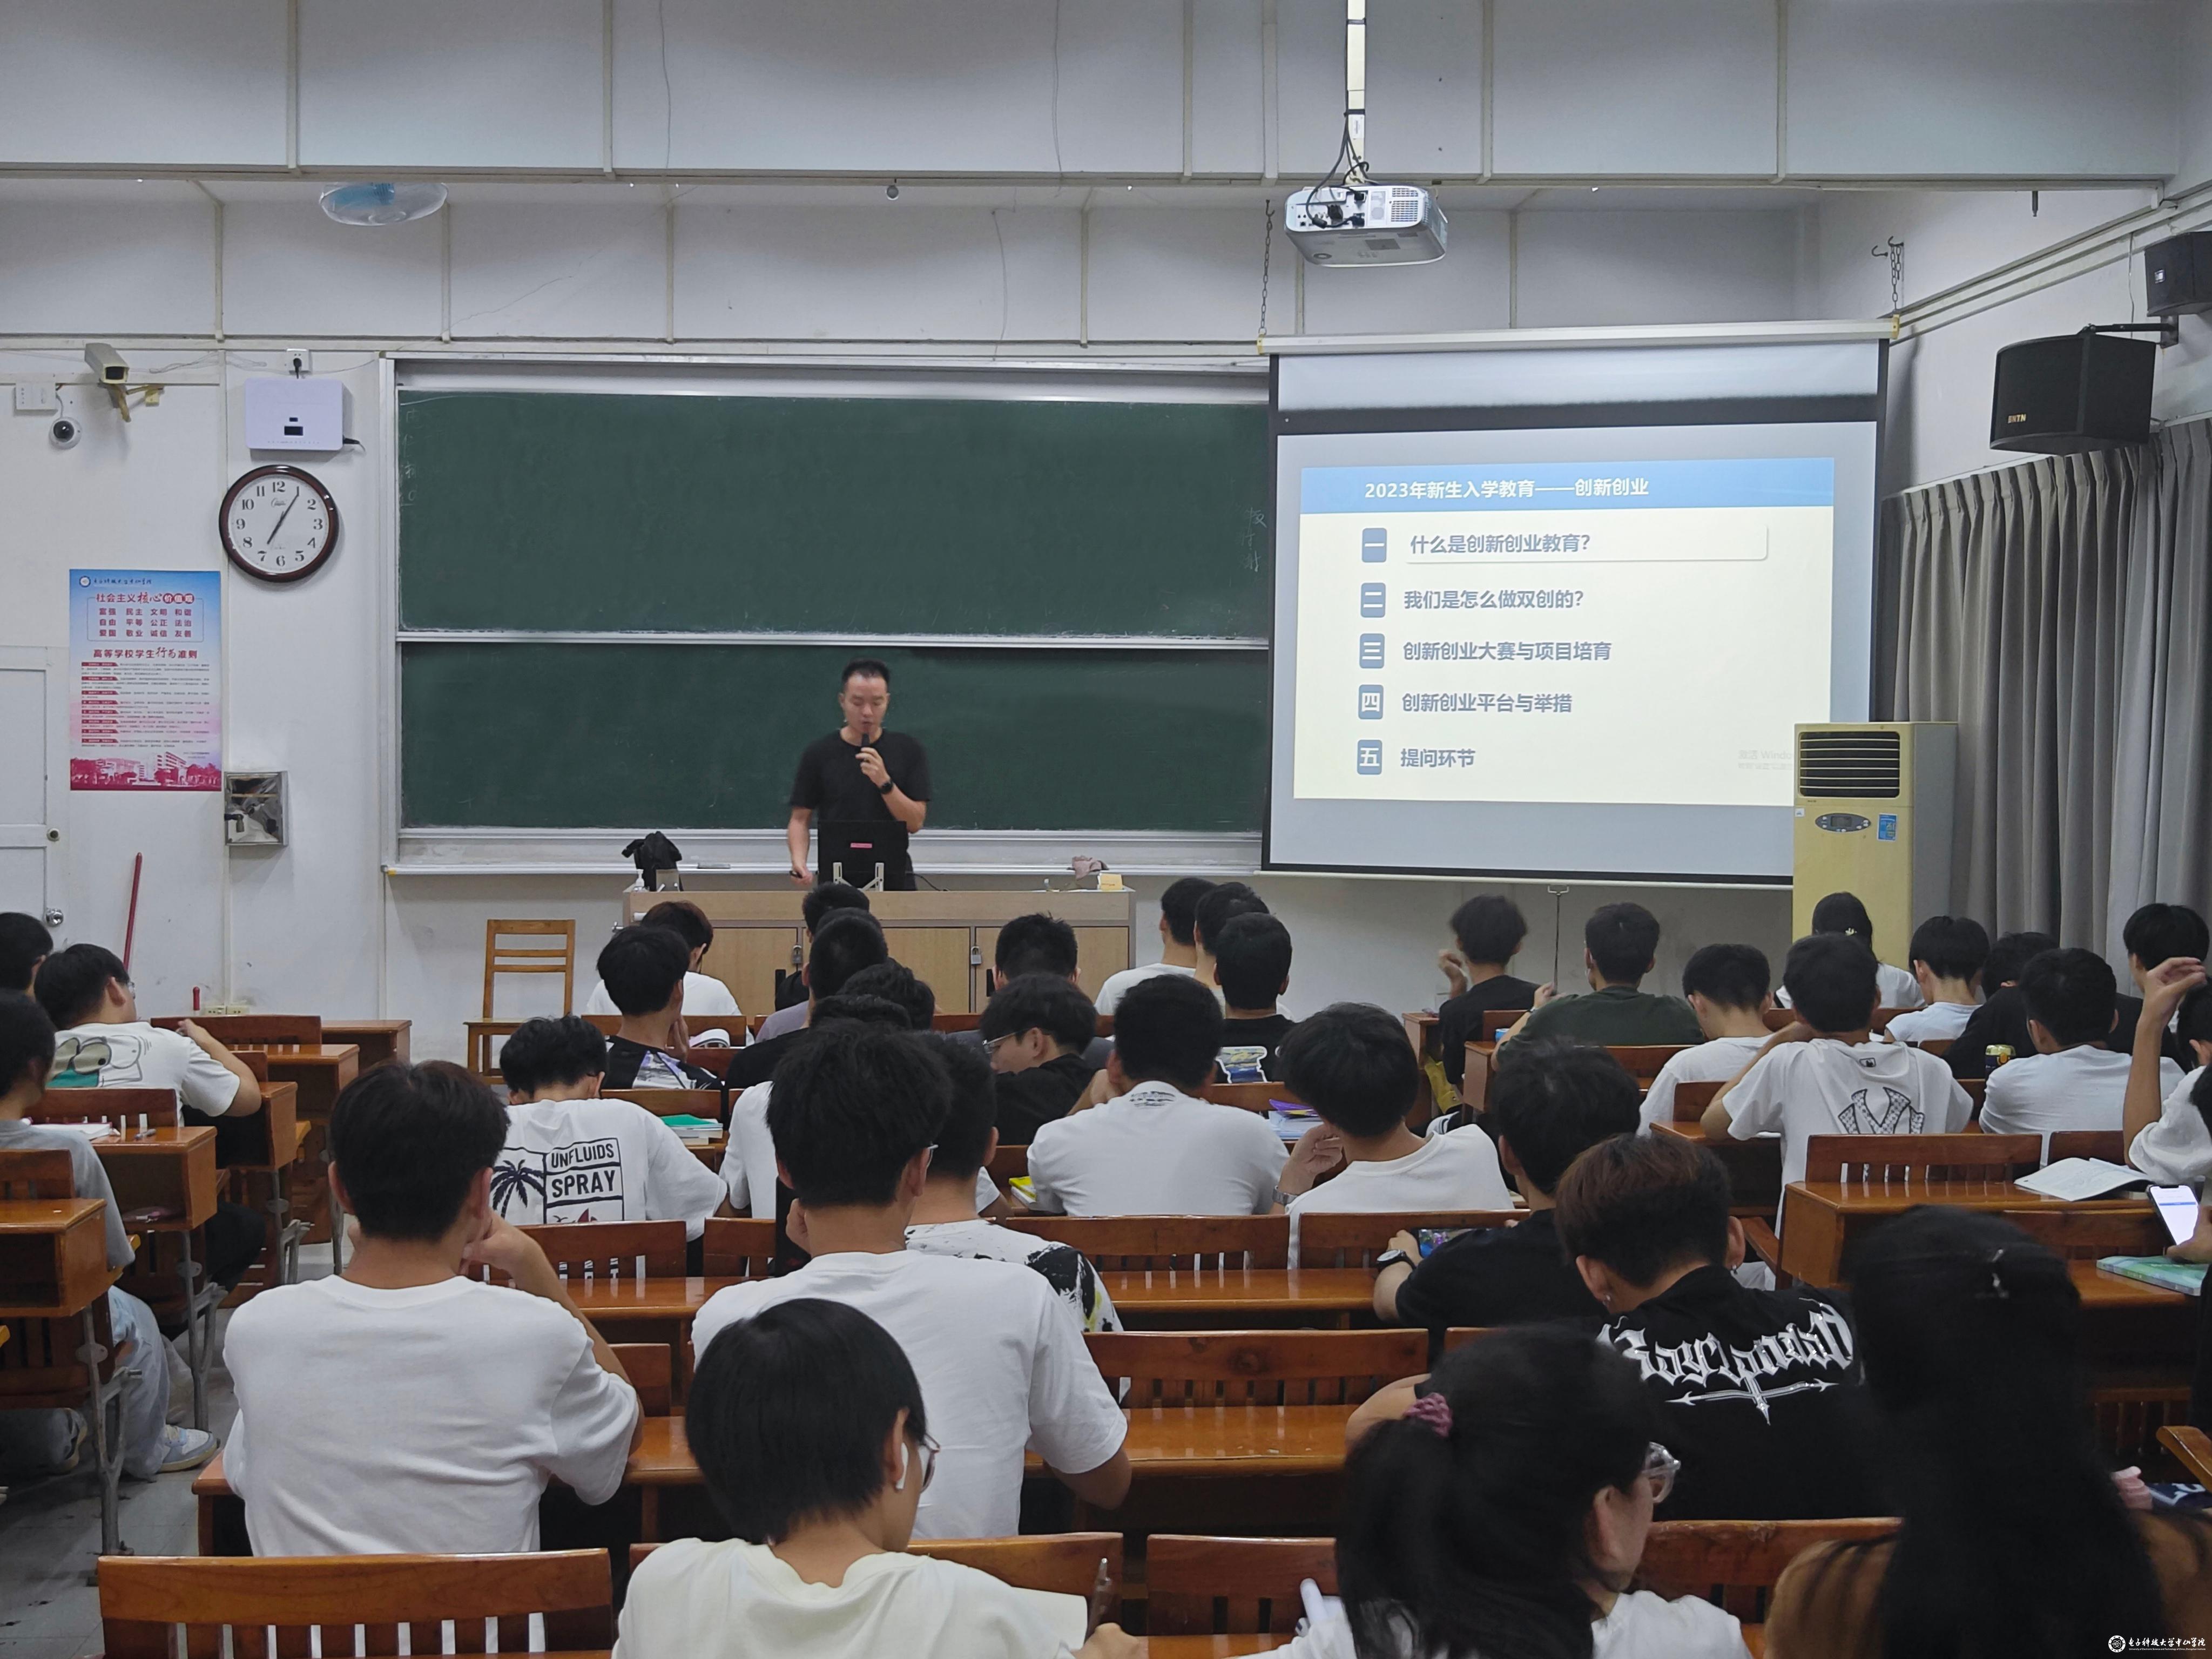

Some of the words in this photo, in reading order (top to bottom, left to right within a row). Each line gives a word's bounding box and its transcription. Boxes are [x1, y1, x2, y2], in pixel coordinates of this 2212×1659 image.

[257, 485, 265, 497] 11
[273, 481, 285, 493] 12
[241, 498, 254, 510] 10
[307, 498, 316, 510] 2
[235, 518, 246, 530] 9
[313, 518, 323, 530] 3
[242, 537, 252, 548] 8
[307, 537, 315, 549] 4
[257, 550, 267, 562] 7
[276, 555, 286, 567] 6
[295, 550, 305, 562] 5
[1363, 591, 1383, 608] 二
[1361, 642, 1382, 660] 三
[1403, 641, 1612, 661] 创新创业大赛与项目培育
[1361, 692, 1380, 712] 四
[1401, 693, 1572, 713] 创新创业平台与举措
[1359, 747, 1380, 767] 五
[1400, 748, 1476, 768] 提问环节
[551, 1143, 615, 1169] UNFLUIDS
[551, 1170, 616, 1198] SPRAY
